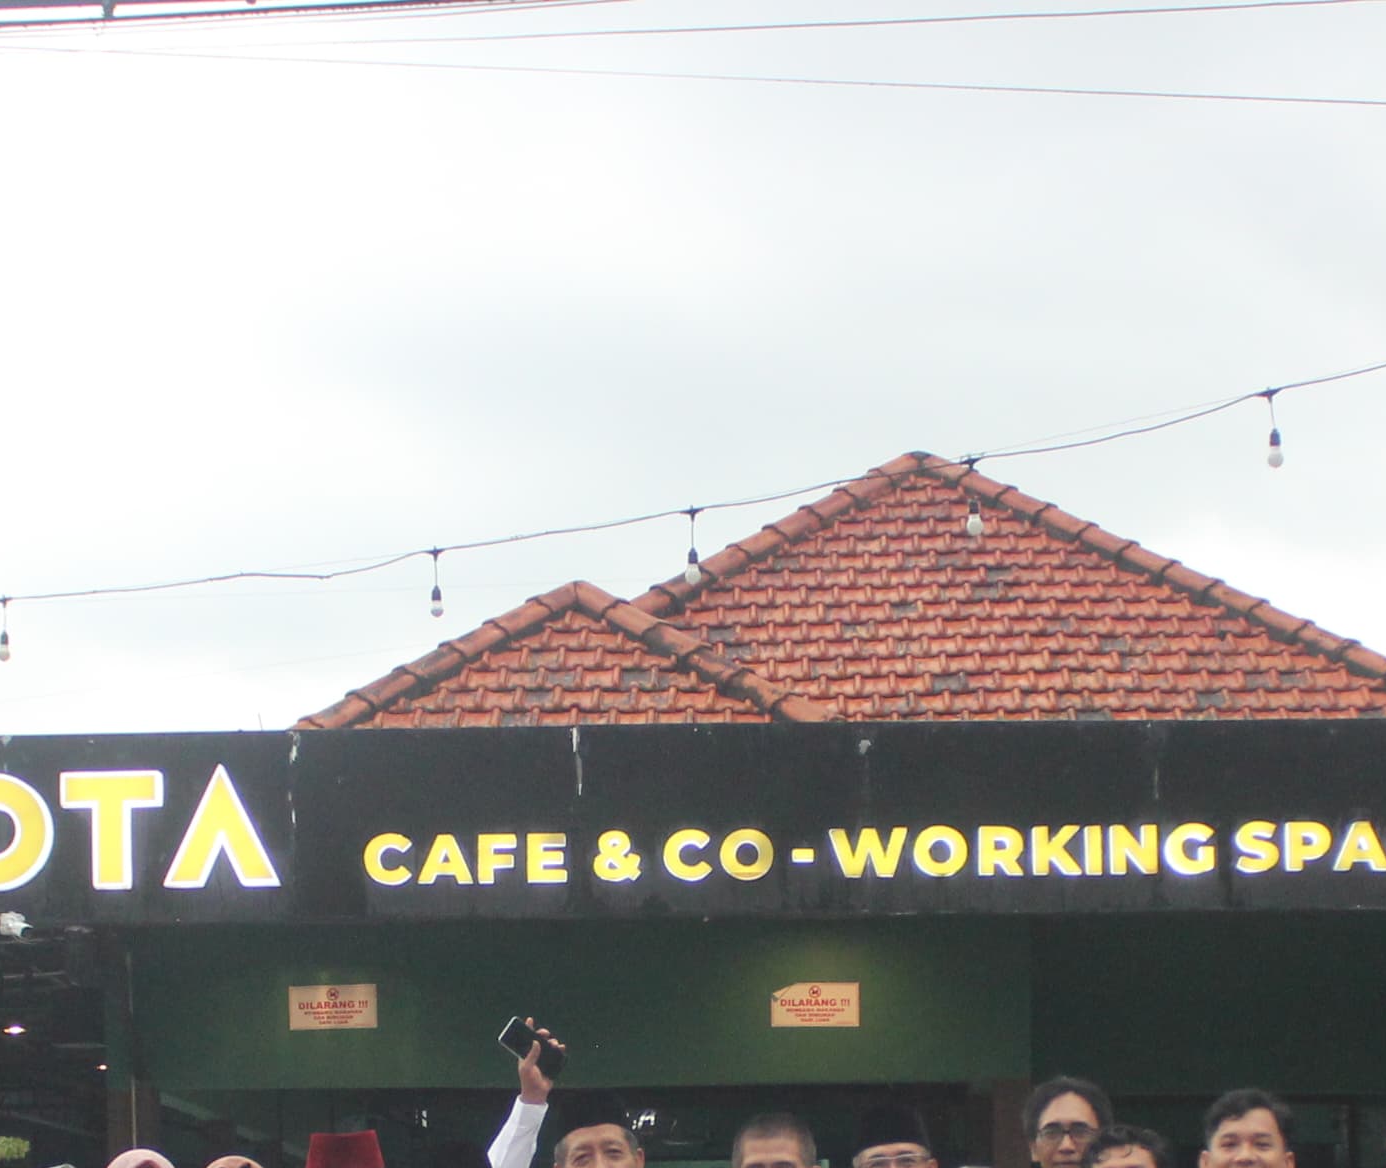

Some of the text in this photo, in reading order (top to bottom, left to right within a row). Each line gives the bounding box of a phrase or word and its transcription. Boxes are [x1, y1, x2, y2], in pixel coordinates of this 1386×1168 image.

[363, 831, 568, 886] CAFE
[592, 829, 642, 882] &
[298, 1000, 355, 1010] DILARANG
[780, 998, 837, 1007] DILARANG
